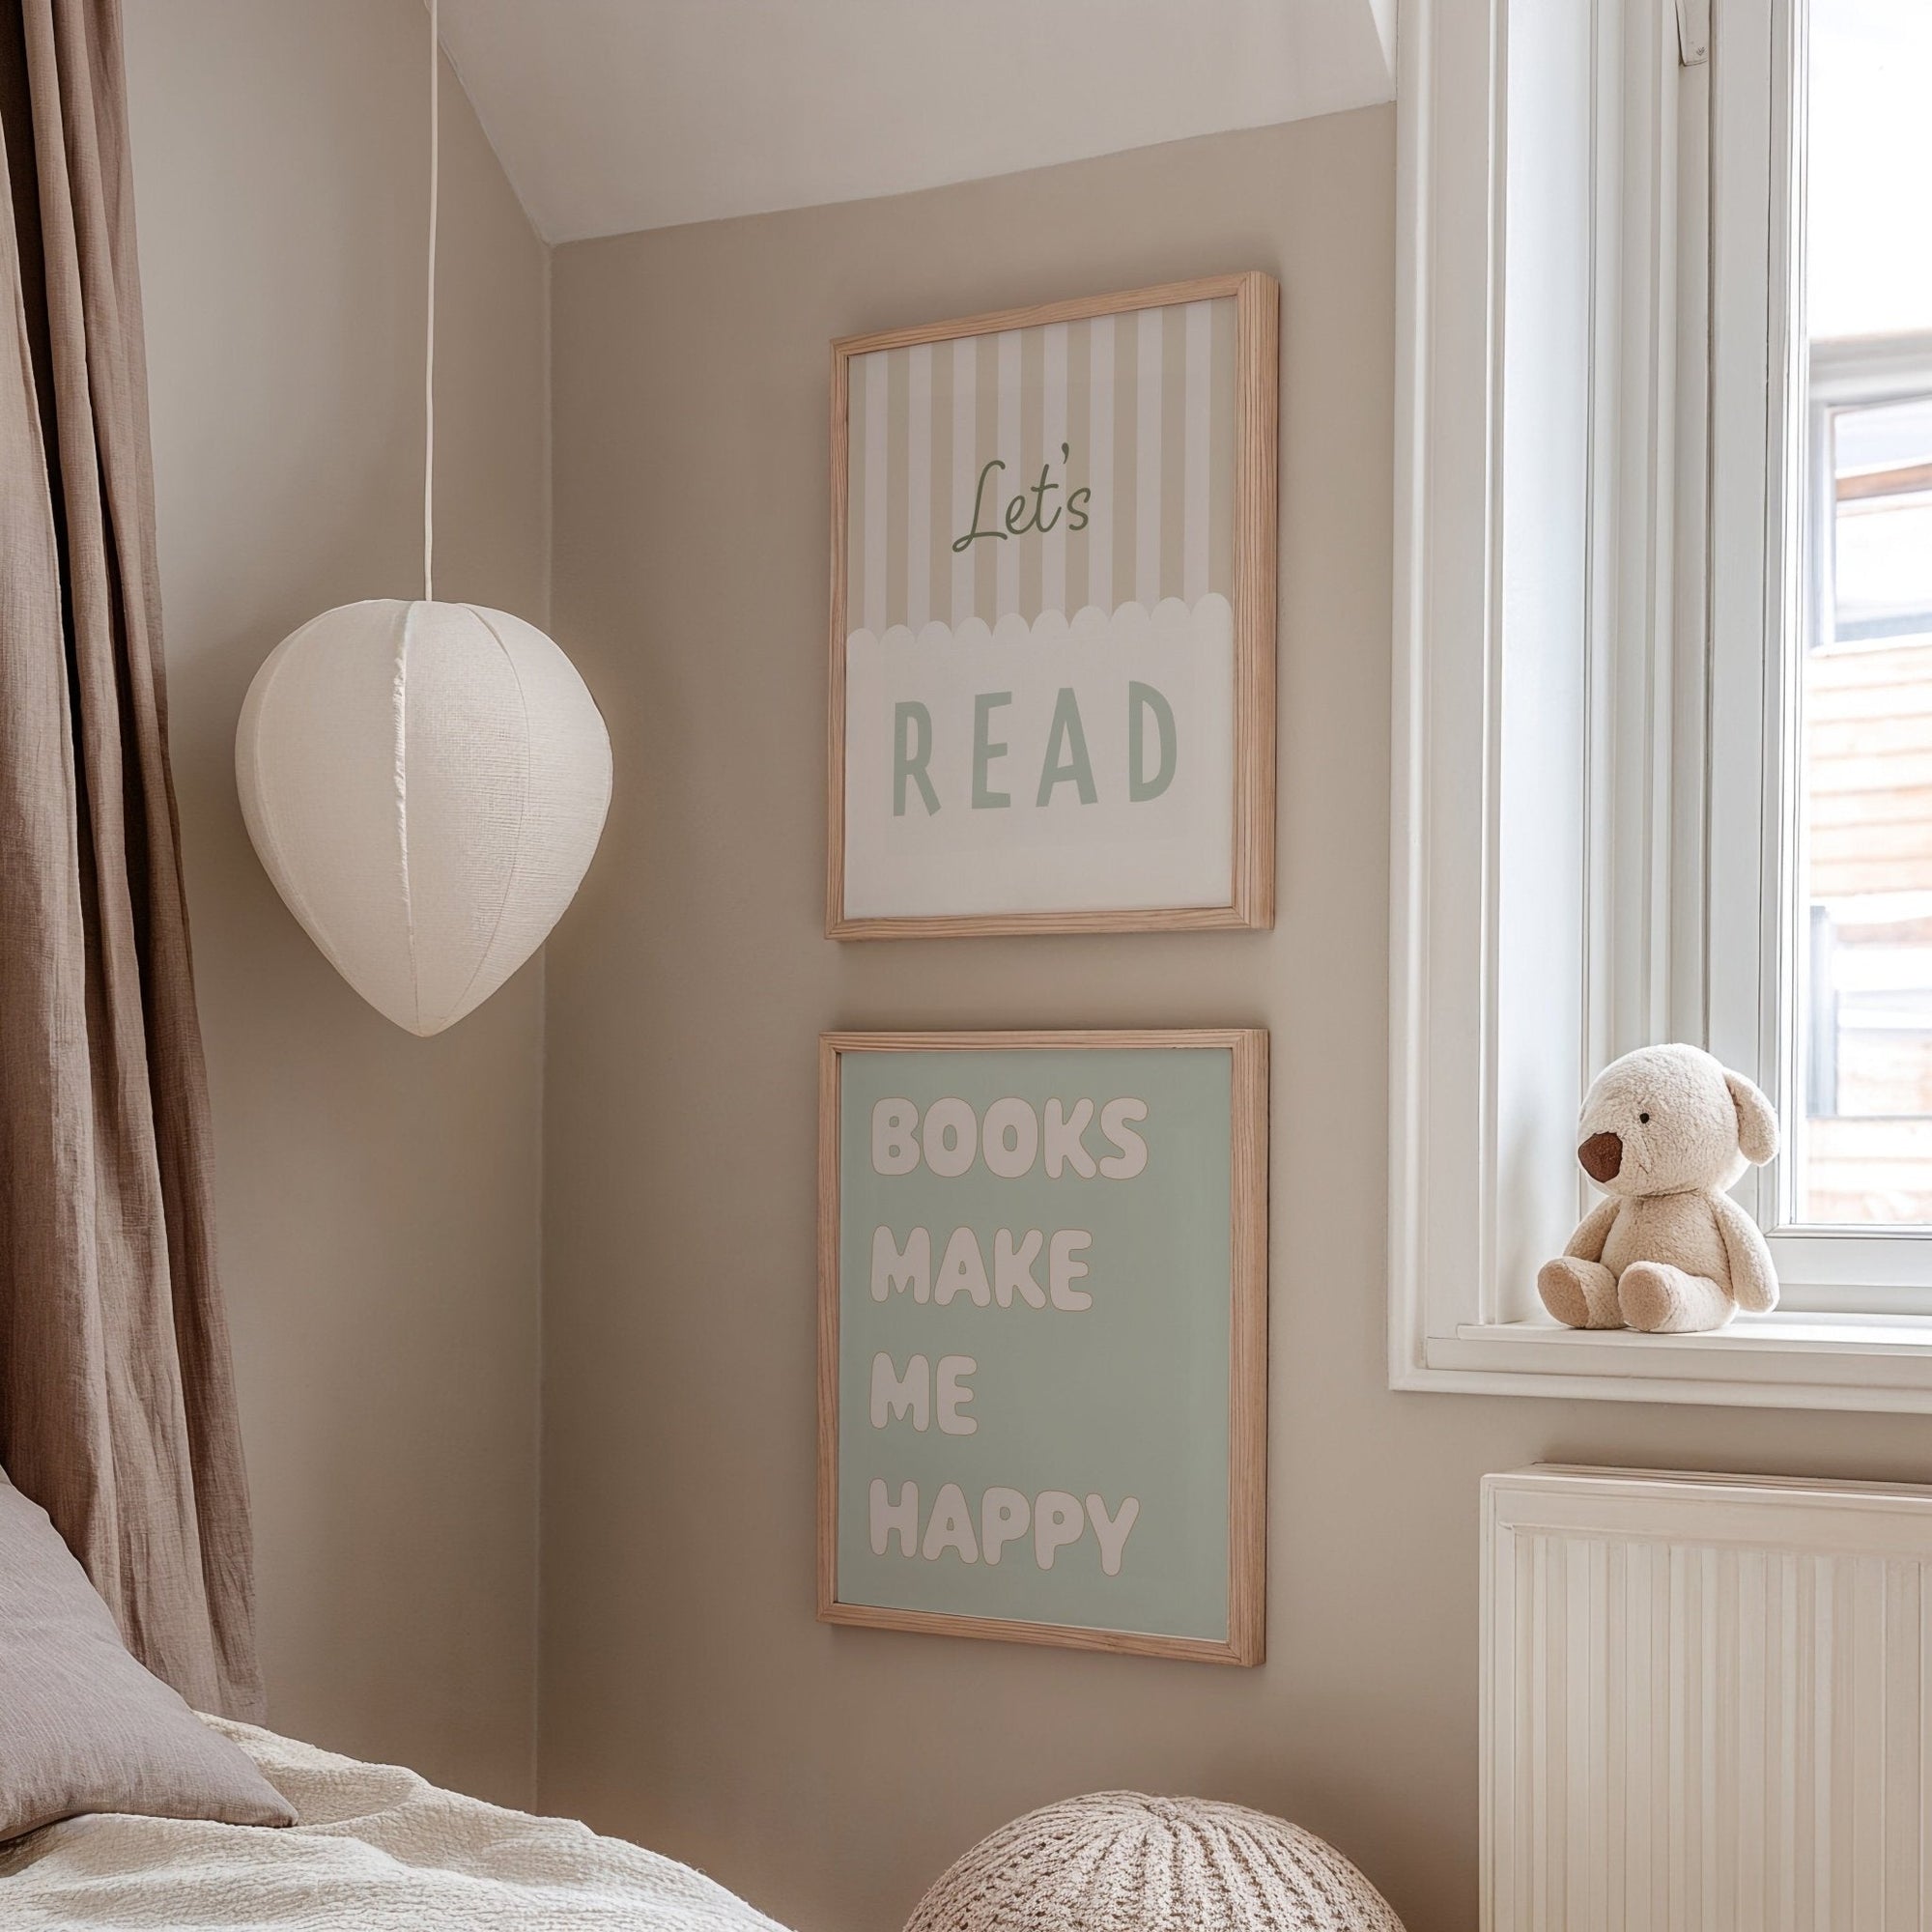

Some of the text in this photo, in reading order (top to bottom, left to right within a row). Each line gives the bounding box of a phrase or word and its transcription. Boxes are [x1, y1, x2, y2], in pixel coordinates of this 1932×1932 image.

[952, 441, 1092, 554] Let's
[892, 679, 1179, 818] READ
[870, 1096, 1150, 1180] BOOKS
[869, 1225, 1094, 1311] MAKE
[868, 1350, 979, 1436] ME
[867, 1478, 1141, 1577] HAPPY
